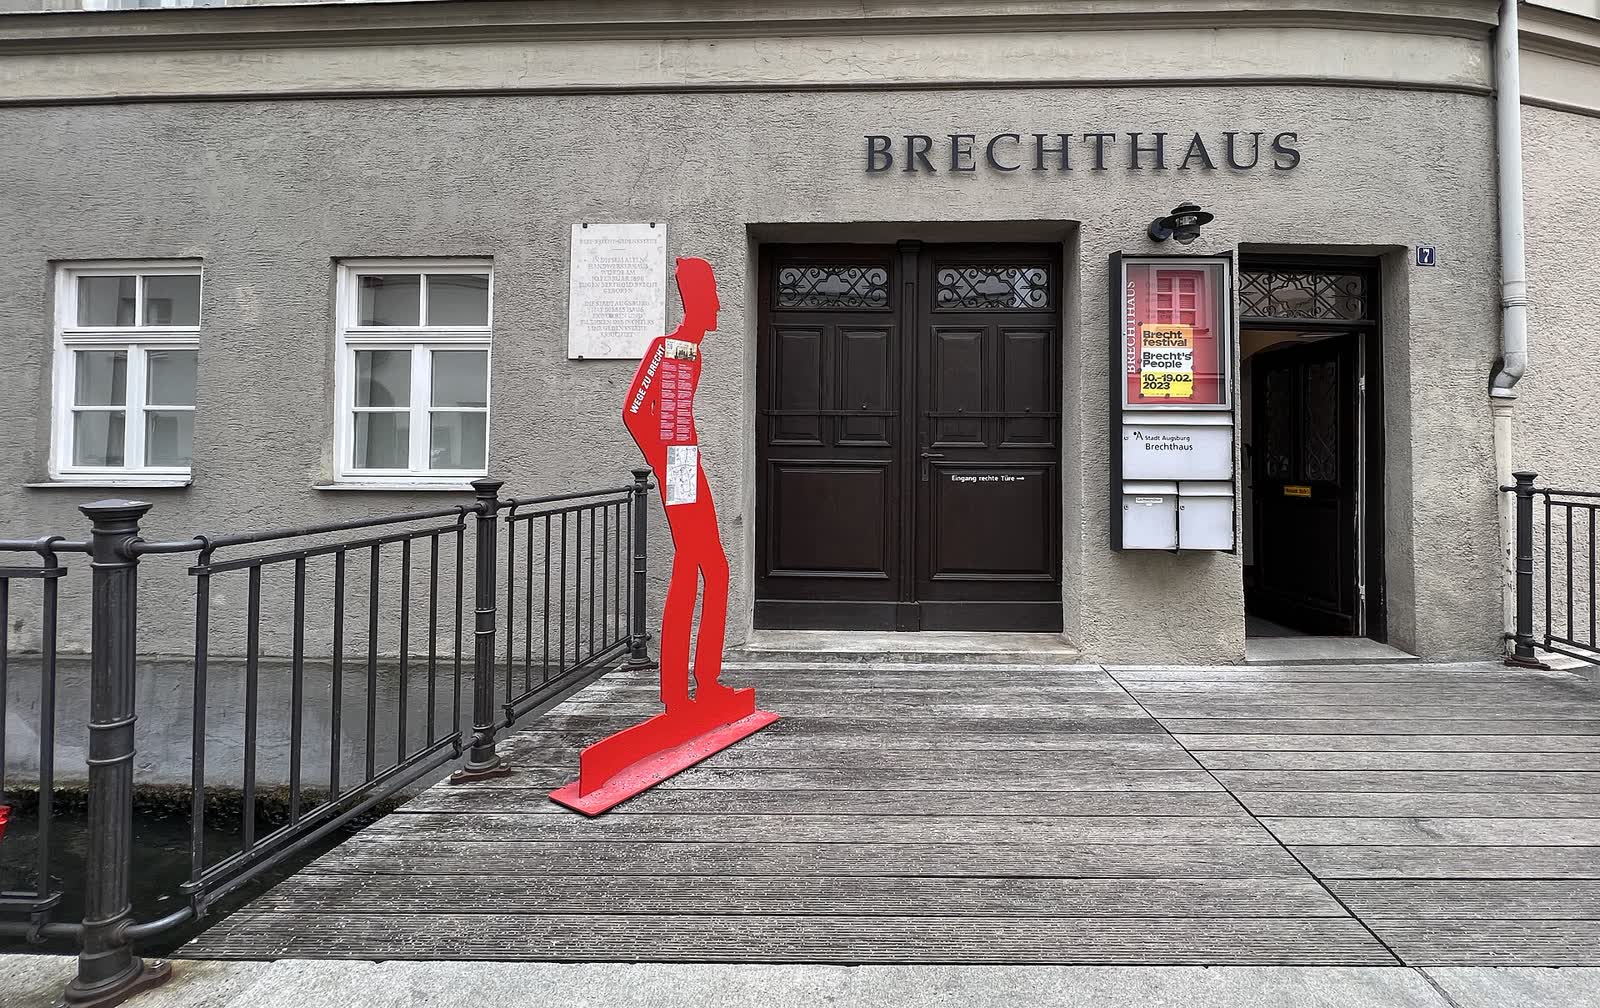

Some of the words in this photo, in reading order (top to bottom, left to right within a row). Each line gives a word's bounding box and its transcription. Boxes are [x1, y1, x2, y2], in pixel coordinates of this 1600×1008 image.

[864, 131, 1301, 173] BRECHTHAUS
[1127, 280, 1136, 374] BRECHTHAUS
[1142, 330, 1183, 339] Brecht
[1142, 338, 1188, 347] festival
[646, 343, 666, 379] BRECHT
[1142, 351, 1192, 361] Brecht's
[1142, 360, 1183, 369] People
[641, 375, 652, 390] ZU
[1142, 373, 1193, 383] 10.-19.02.
[1142, 381, 1171, 390] 2023
[629, 387, 647, 415] WEGE
[1145, 442, 1194, 451] Brechthaus
[951, 474, 977, 483] Eingang
[978, 474, 999, 482] rechte
[1000, 474, 1015, 482] Türe
